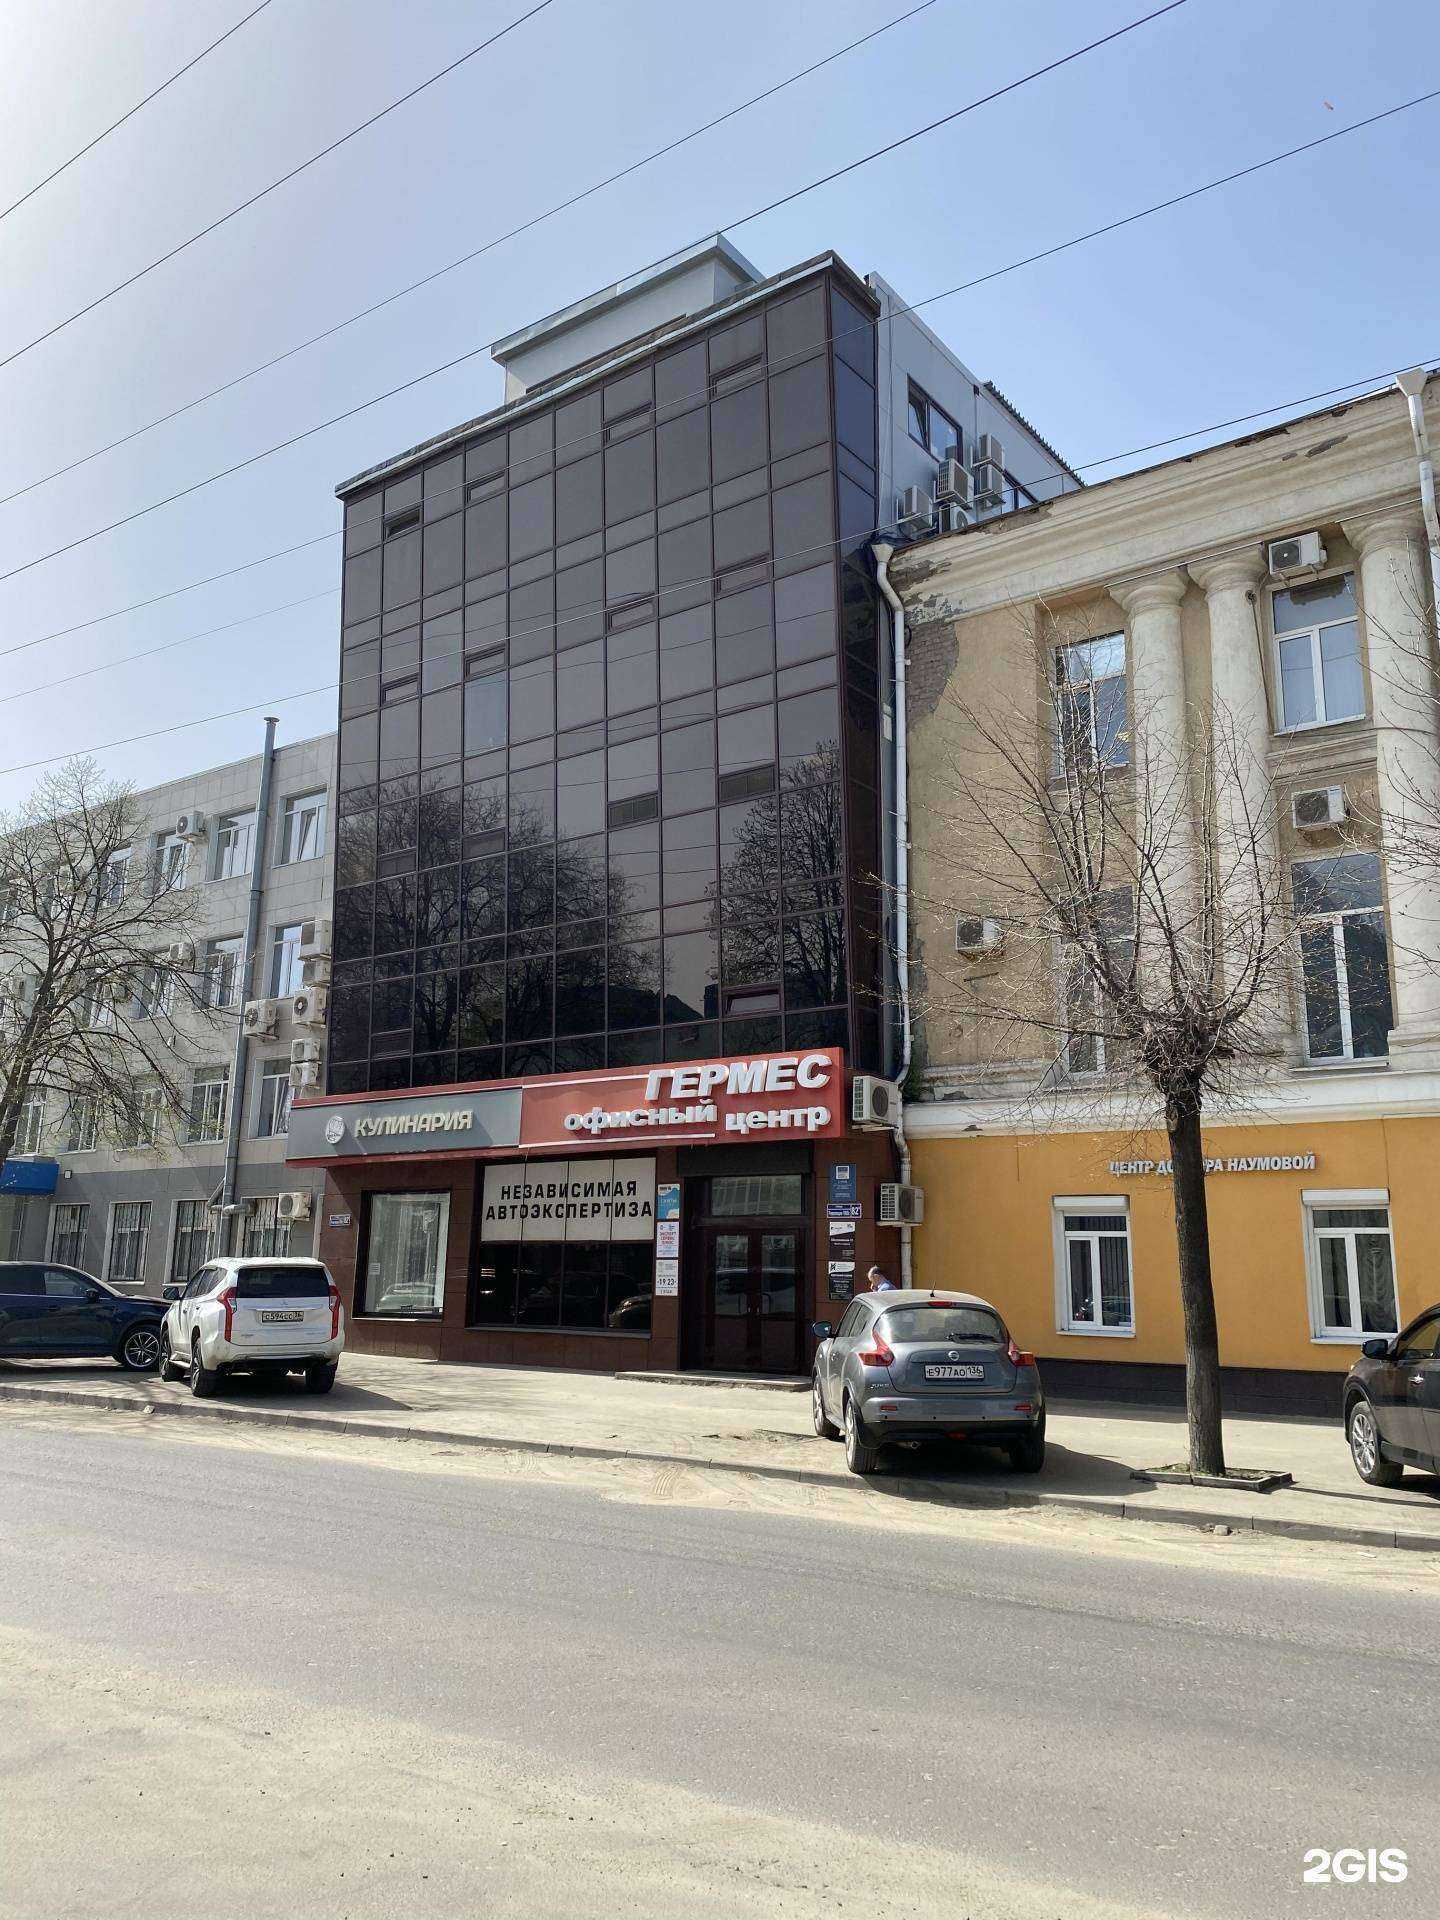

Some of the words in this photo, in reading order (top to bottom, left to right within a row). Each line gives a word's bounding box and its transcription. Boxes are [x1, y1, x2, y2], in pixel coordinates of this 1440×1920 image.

[645, 1054, 832, 1100] ГЕРМЕС
[354, 1110, 474, 1138] КУЛИНАРИЯ
[564, 1098, 718, 1134] офисный
[726, 1105, 831, 1134] центр
[1109, 1159, 1155, 1177] ЦЕНТР
[1228, 1150, 1316, 1172] НАУМОВОЙ
[501, 1180, 637, 1200] НЕЗАВИСИМАЯ
[486, 1201, 653, 1220] АВТОЭКСПЕРТИЗА
